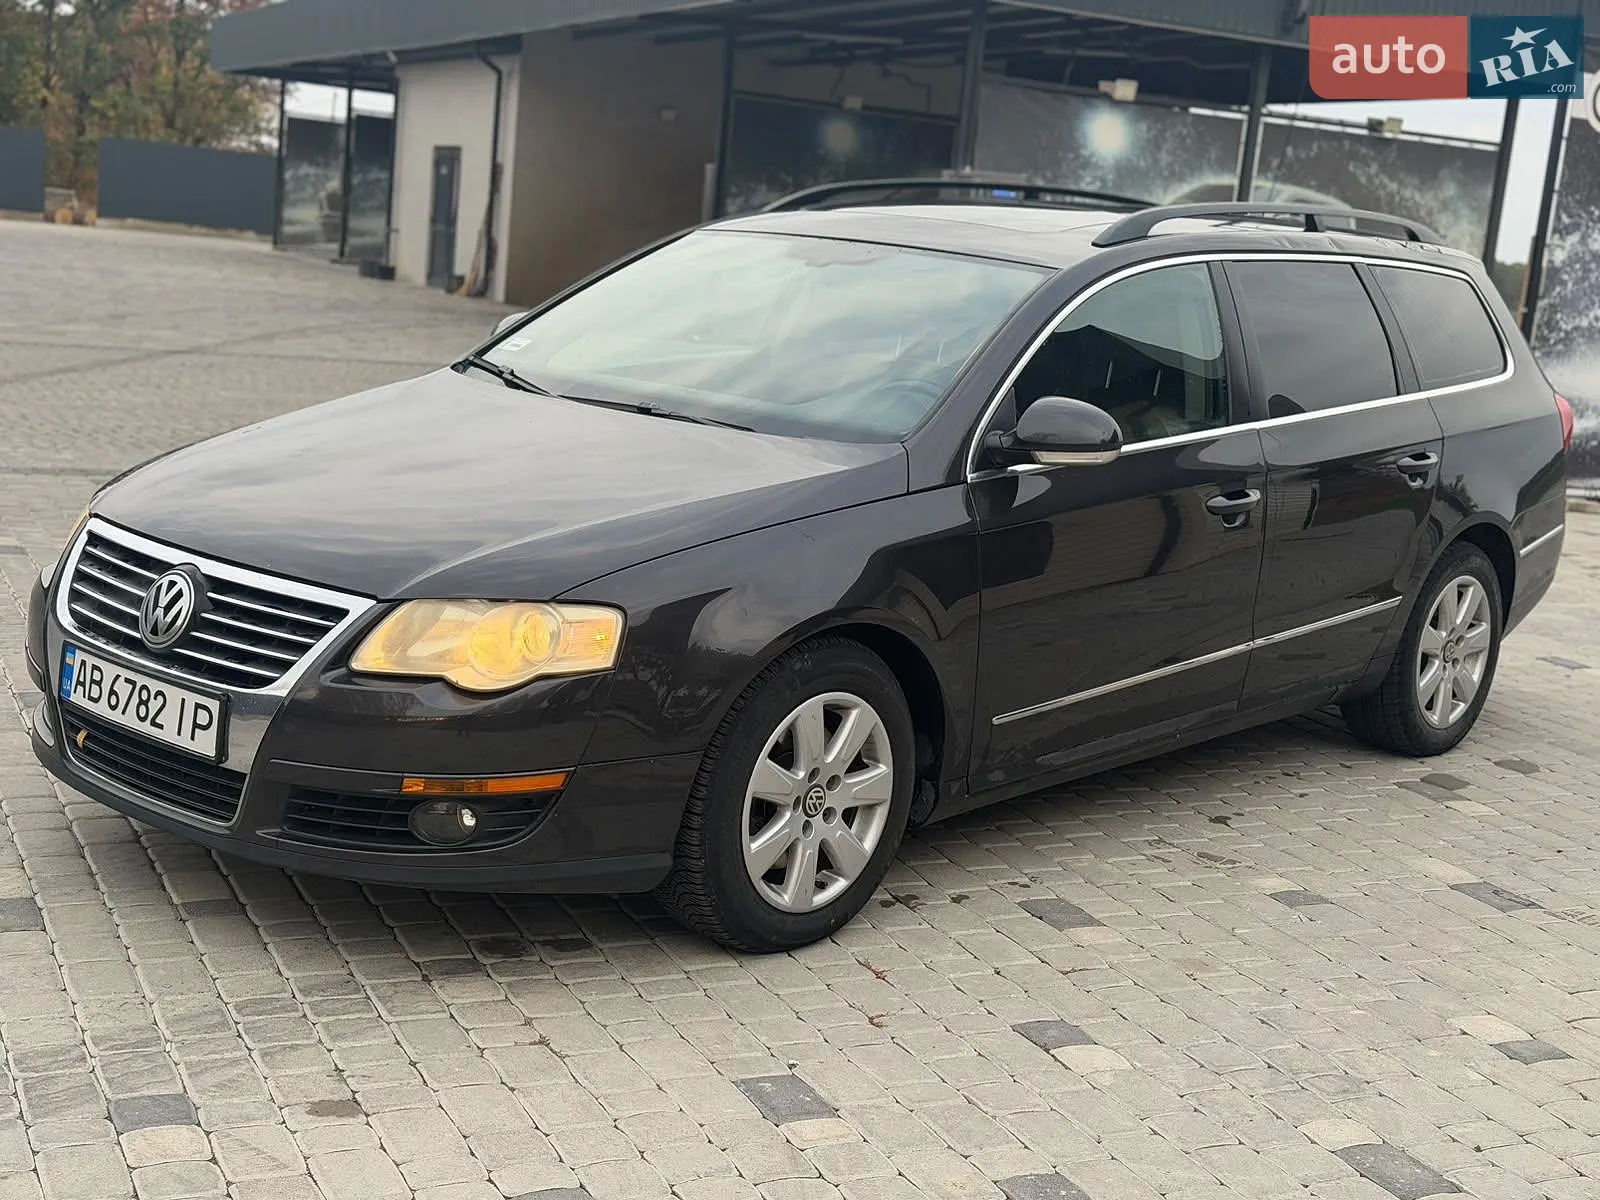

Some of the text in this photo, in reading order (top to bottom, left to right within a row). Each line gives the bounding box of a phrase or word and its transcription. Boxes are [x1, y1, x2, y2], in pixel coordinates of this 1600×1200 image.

[62, 677, 71, 691] UA
[73, 659, 214, 742] AB 6782 IP
